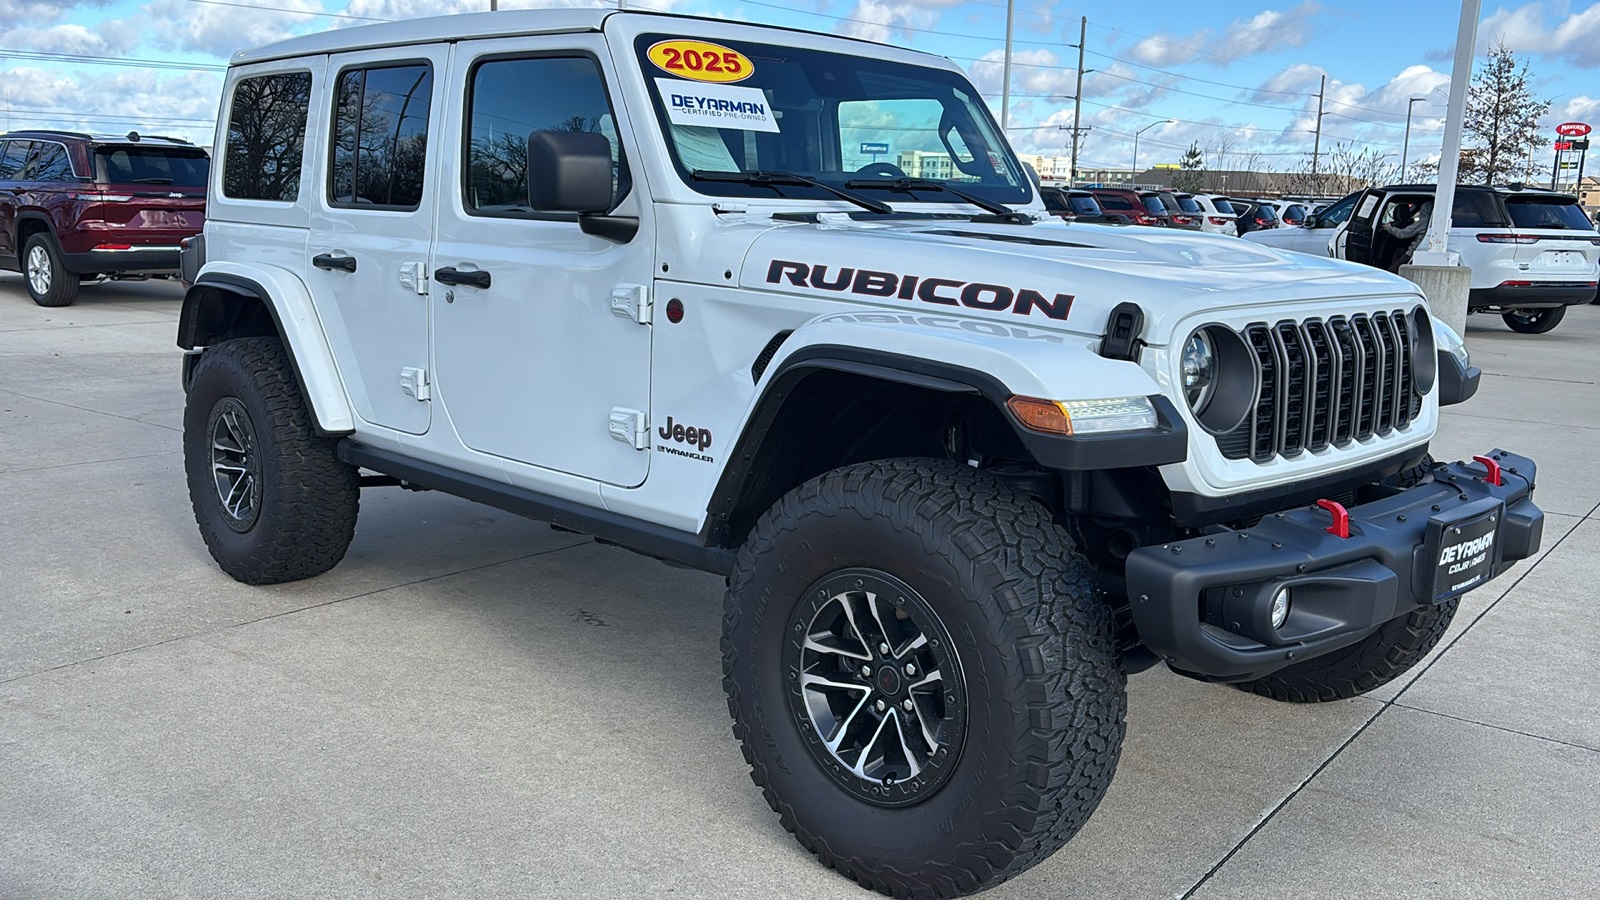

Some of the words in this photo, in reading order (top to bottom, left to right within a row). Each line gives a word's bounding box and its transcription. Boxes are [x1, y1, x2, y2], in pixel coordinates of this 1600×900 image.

[662, 47, 742, 74] 2025
[671, 93, 765, 115] DEYARMAN
[682, 107, 722, 117] CERTIFIED
[724, 111, 767, 121] PRE-OWNED
[766, 259, 1075, 321] RUBICON
[658, 416, 712, 452] Jeep
[665, 446, 714, 463] WRANGLER
[1439, 529, 1495, 566] DEYARMAN
